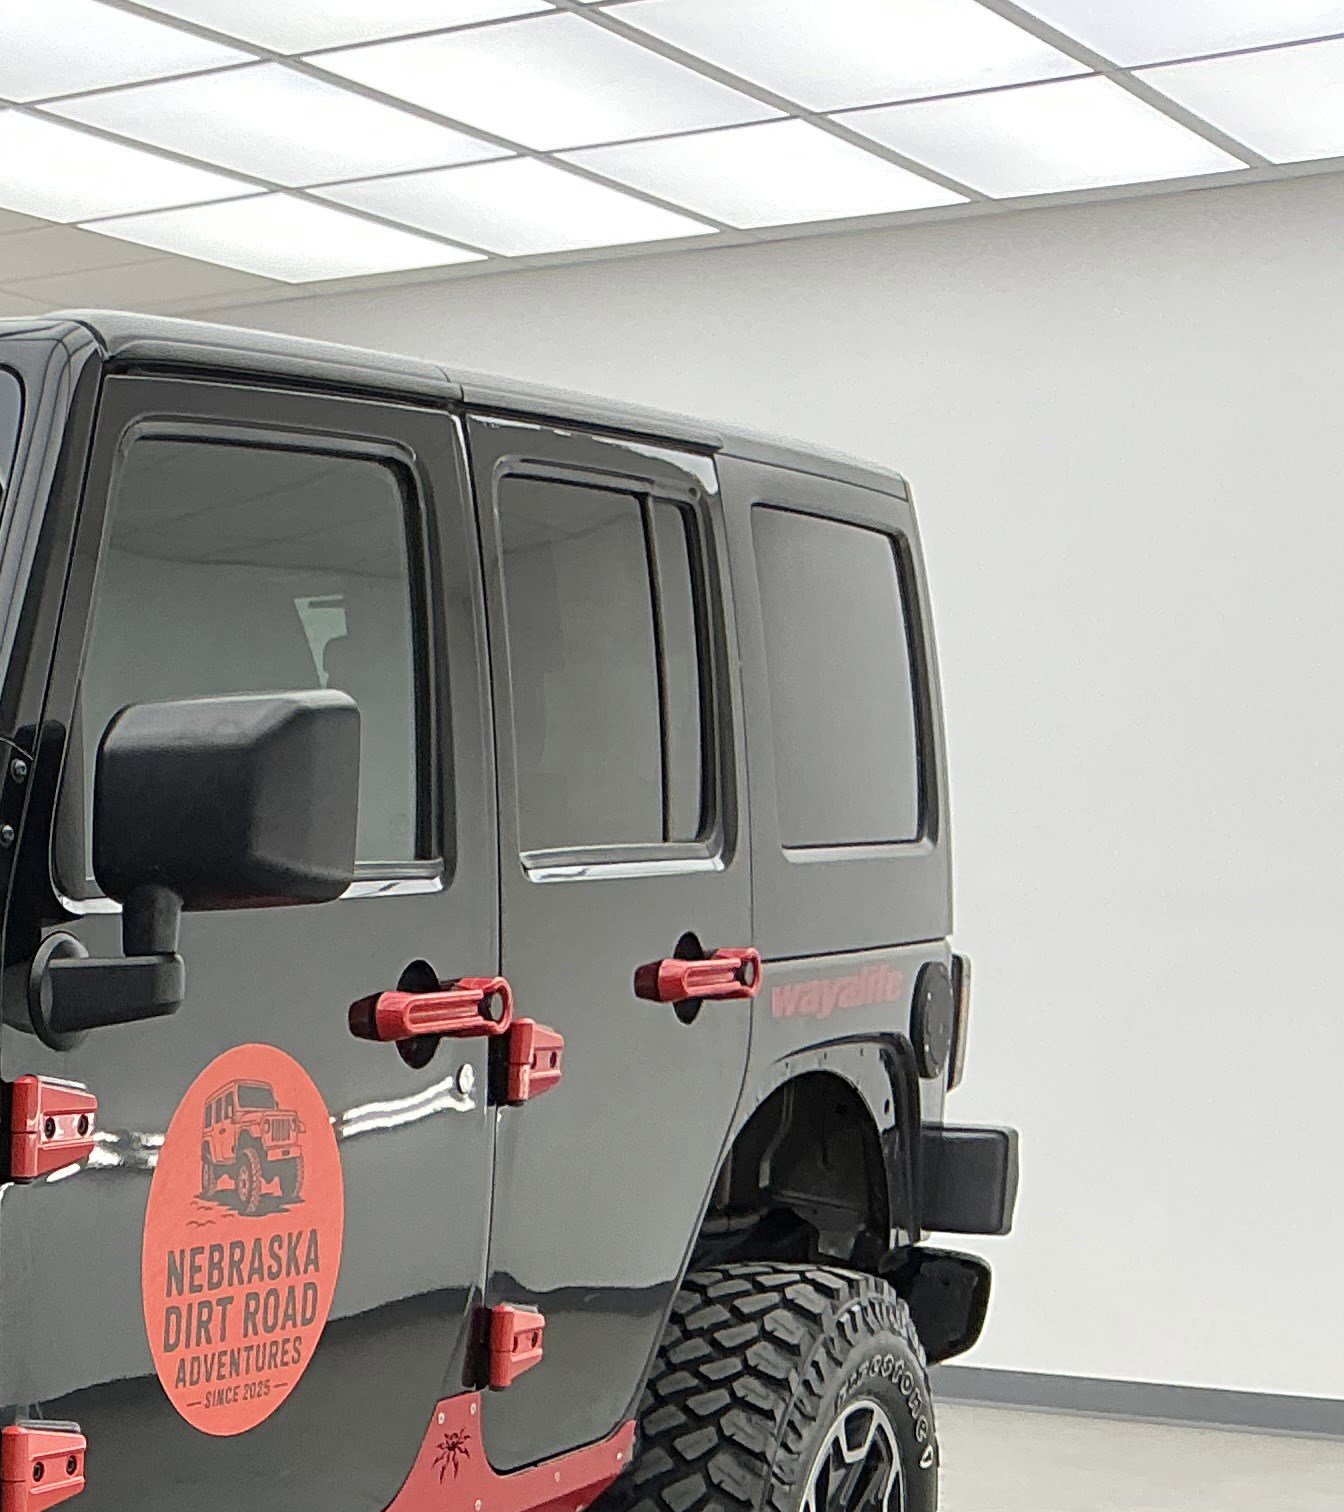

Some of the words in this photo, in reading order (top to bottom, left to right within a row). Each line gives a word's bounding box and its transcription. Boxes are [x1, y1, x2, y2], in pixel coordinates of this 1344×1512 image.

[166, 1229, 320, 1298] NEBRASKA
[163, 1296, 234, 1353] DIRT
[243, 1282, 319, 1338] ROAD
[175, 1336, 303, 1389] ADVENTURES
[205, 1385, 240, 1408] SINCE
[242, 1379, 271, 1400] 2025
